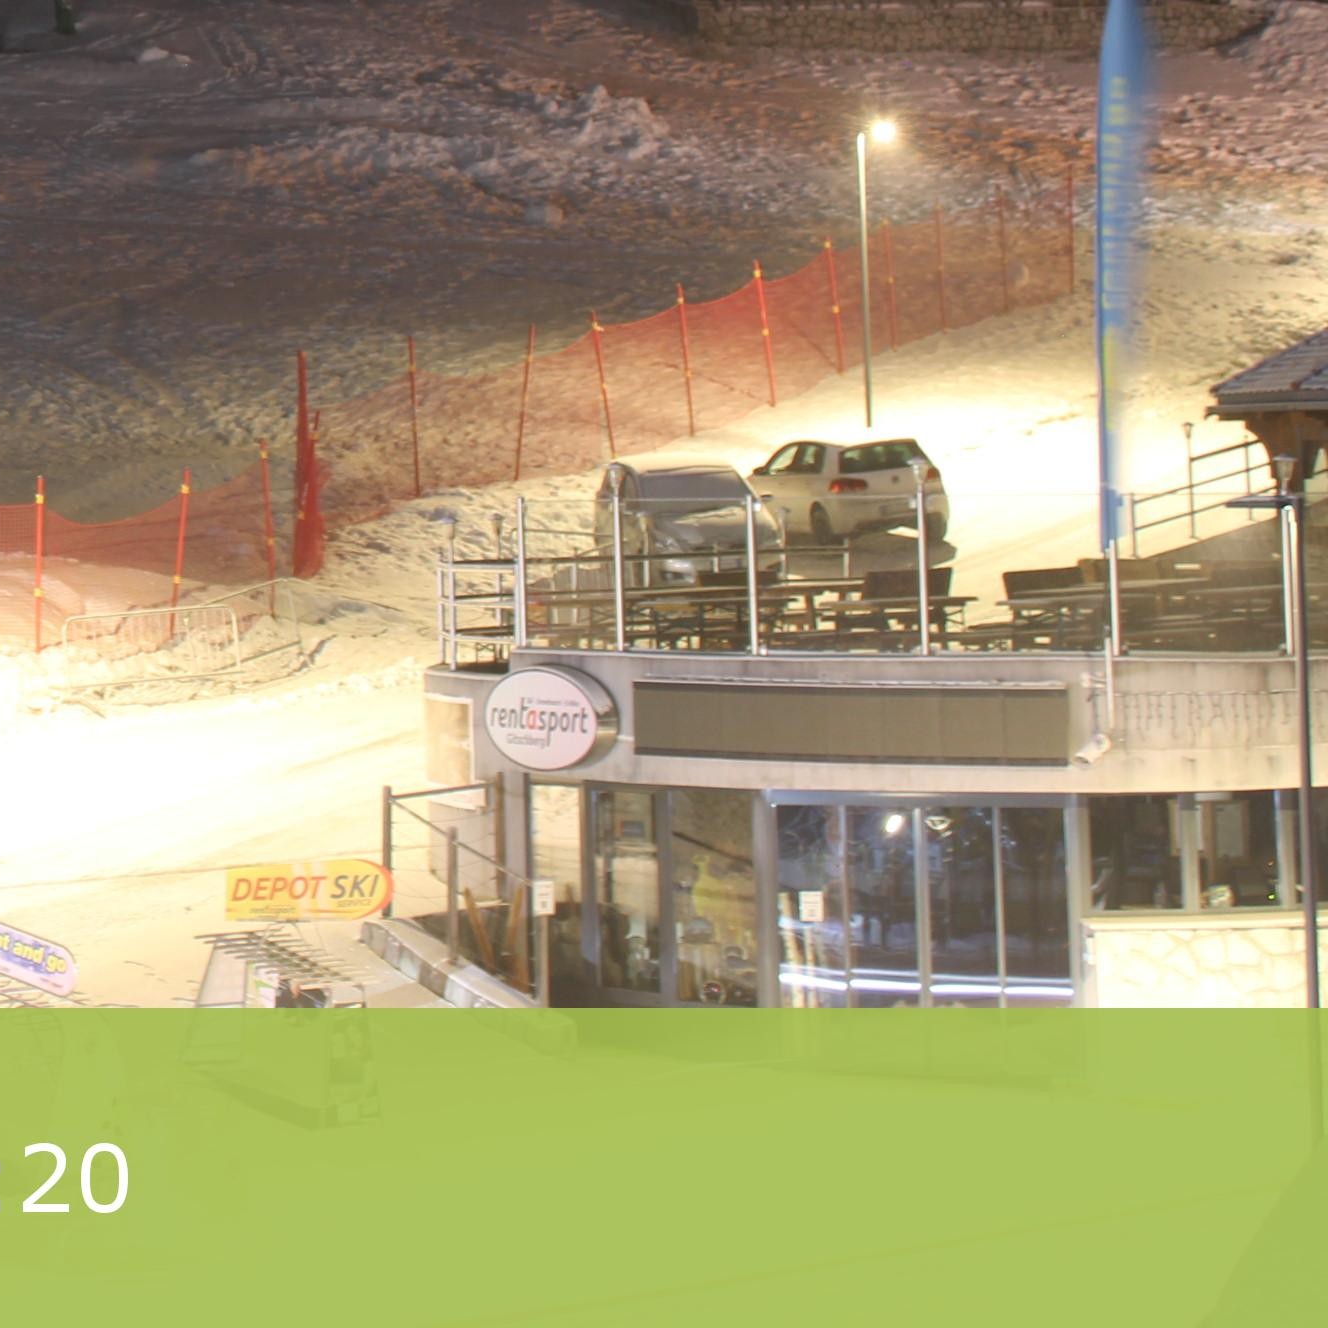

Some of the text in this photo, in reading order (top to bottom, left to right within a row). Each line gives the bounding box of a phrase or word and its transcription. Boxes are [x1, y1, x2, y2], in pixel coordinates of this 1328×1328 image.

[231, 874, 380, 901] DEPOT SKI
[12, 941, 44, 965] and
[46, 952, 67, 973] go
